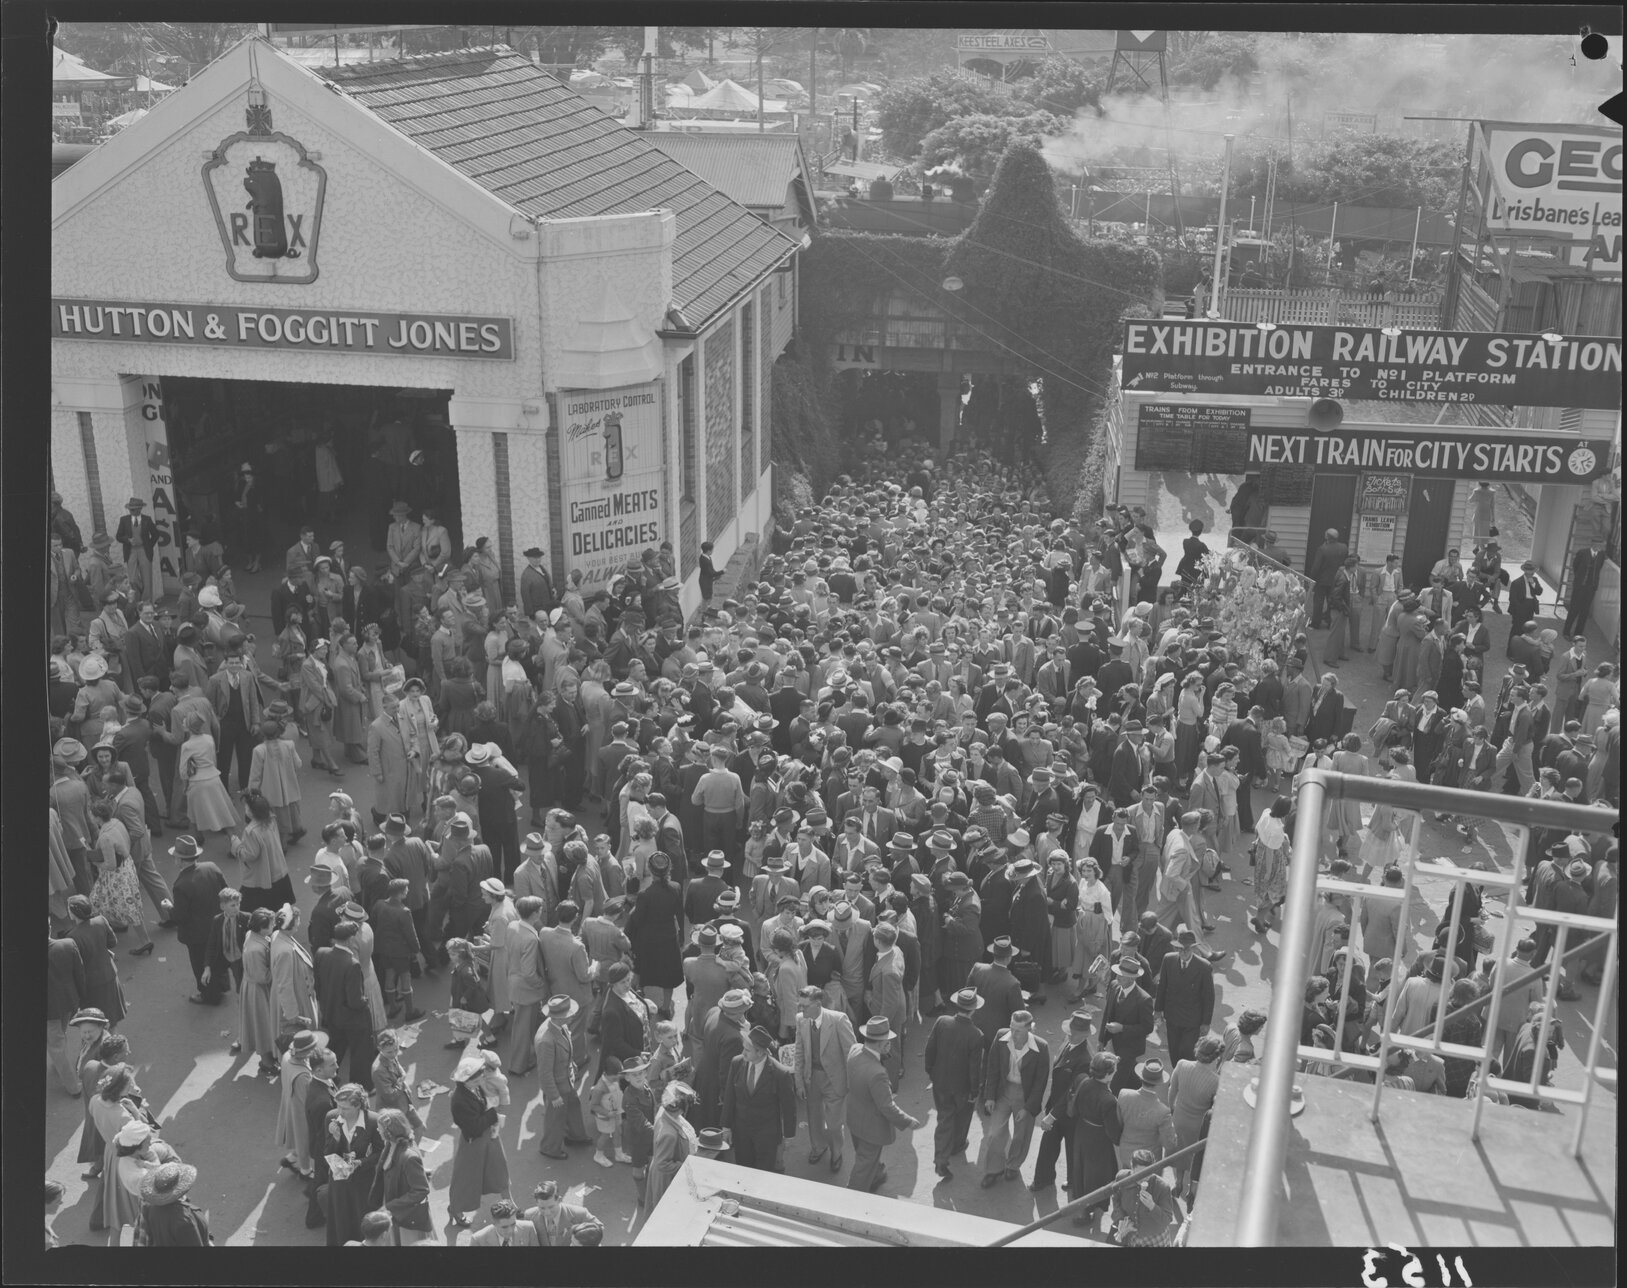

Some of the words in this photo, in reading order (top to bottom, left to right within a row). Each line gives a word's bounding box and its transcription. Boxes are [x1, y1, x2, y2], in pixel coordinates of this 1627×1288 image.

[1004, 37, 1026, 48] AXES
[230, 212, 307, 248] REX
[59, 304, 195, 339] HUTTON
[203, 313, 228, 344] &
[236, 312, 379, 349] FOGGITT
[388, 319, 502, 353] JONES
[837, 344, 876, 363] IN
[1127, 324, 1313, 361] EXHIBITION
[1332, 331, 1470, 366] RAILWAY
[1486, 339, 1622, 373] STATION
[1164, 373, 1194, 381] Platform
[1198, 374, 1225, 383] through
[1231, 363, 1323, 377] ENTRANCE
[1340, 366, 1361, 379] TO
[1423, 370, 1517, 385] PLATFORM
[1265, 385, 1320, 397] ADULTS
[1378, 389, 1458, 402] CHILDREN
[1301, 377, 1352, 389] FARES
[1370, 379, 1388, 390] TO
[1406, 381, 1442, 392] CITY
[567, 397, 621, 416] LABORATORY
[623, 393, 656, 408] CONTROL
[1178, 407, 1198, 415] FROM
[1205, 408, 1246, 417] EXHIBITION
[566, 418, 601, 443] Makes
[591, 444, 640, 466] REX
[1249, 434, 1309, 464] NEXT
[1314, 436, 1385, 467] TRAIN
[1386, 448, 1413, 468] FOR
[1415, 440, 1472, 470] CITY
[1473, 443, 1563, 474] STARTS
[150, 474, 172, 485] AND
[571, 497, 611, 524] Canned
[613, 489, 658, 516] MEATS
[607, 519, 623, 527] AND
[585, 558, 606, 569] YOUR
[609, 554, 627, 565] BEST
